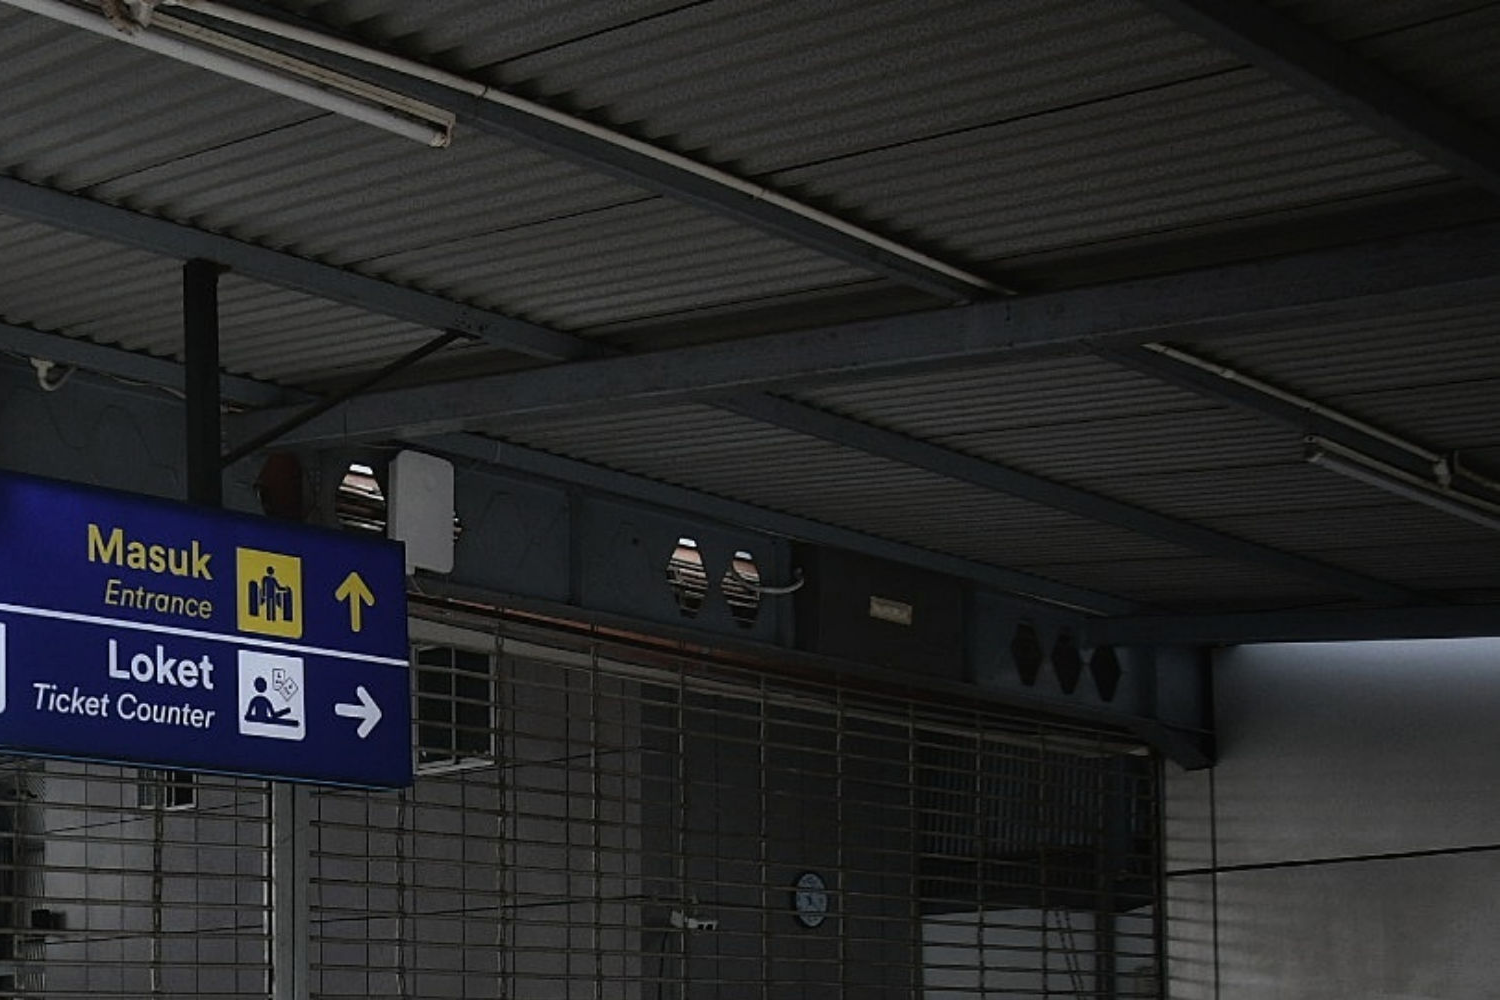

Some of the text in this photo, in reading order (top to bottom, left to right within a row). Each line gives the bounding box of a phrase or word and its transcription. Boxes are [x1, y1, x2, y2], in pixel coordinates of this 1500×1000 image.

[87, 523, 214, 581] Masuk
[105, 578, 213, 619] Entrance
[107, 638, 215, 691] Loket
[32, 682, 216, 729] Ticket Counter
